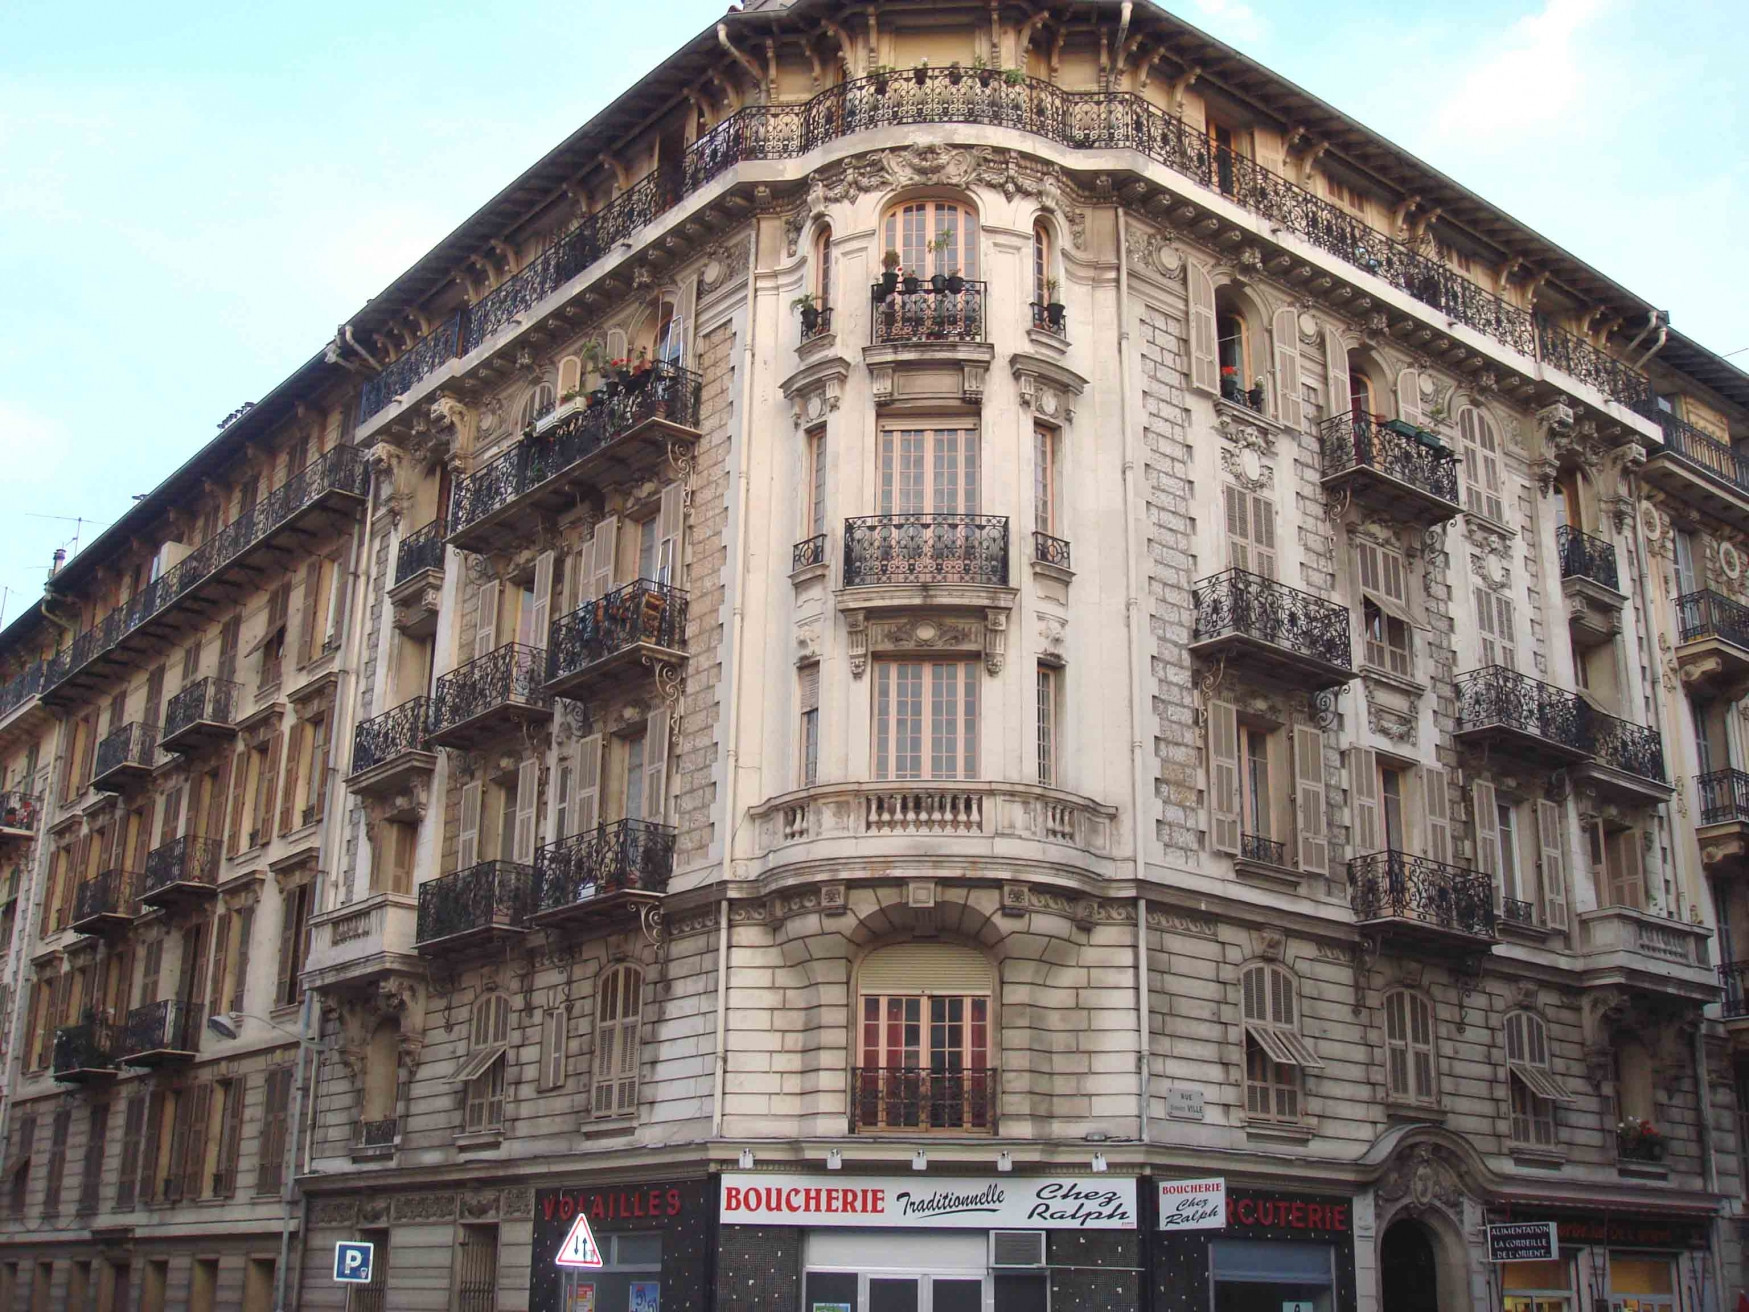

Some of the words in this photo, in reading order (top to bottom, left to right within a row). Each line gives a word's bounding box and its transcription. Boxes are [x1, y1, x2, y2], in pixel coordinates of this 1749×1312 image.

[1180, 1093, 1193, 1101] RUE
[1187, 1105, 1203, 1114] VILLE
[1035, 1183, 1122, 1207] Chez
[1162, 1183, 1222, 1195] BOUCHERIE
[541, 1189, 682, 1221] VOLAILLES
[724, 1186, 885, 1214] BOUCHERIE
[896, 1183, 1005, 1216] Traditionnelle
[1176, 1197, 1209, 1212] Chez
[1027, 1203, 1130, 1226] Ralph
[1165, 1206, 1219, 1227] Ralph
[1226, 1197, 1347, 1231] RCUTERIE
[1491, 1225, 1549, 1236] ALIMENTATION
[1494, 1239, 1504, 1248] LA
[1506, 1238, 1548, 1248] CORBEILLE
[344, 1249, 362, 1274] P
[1497, 1250, 1508, 1259] DE
